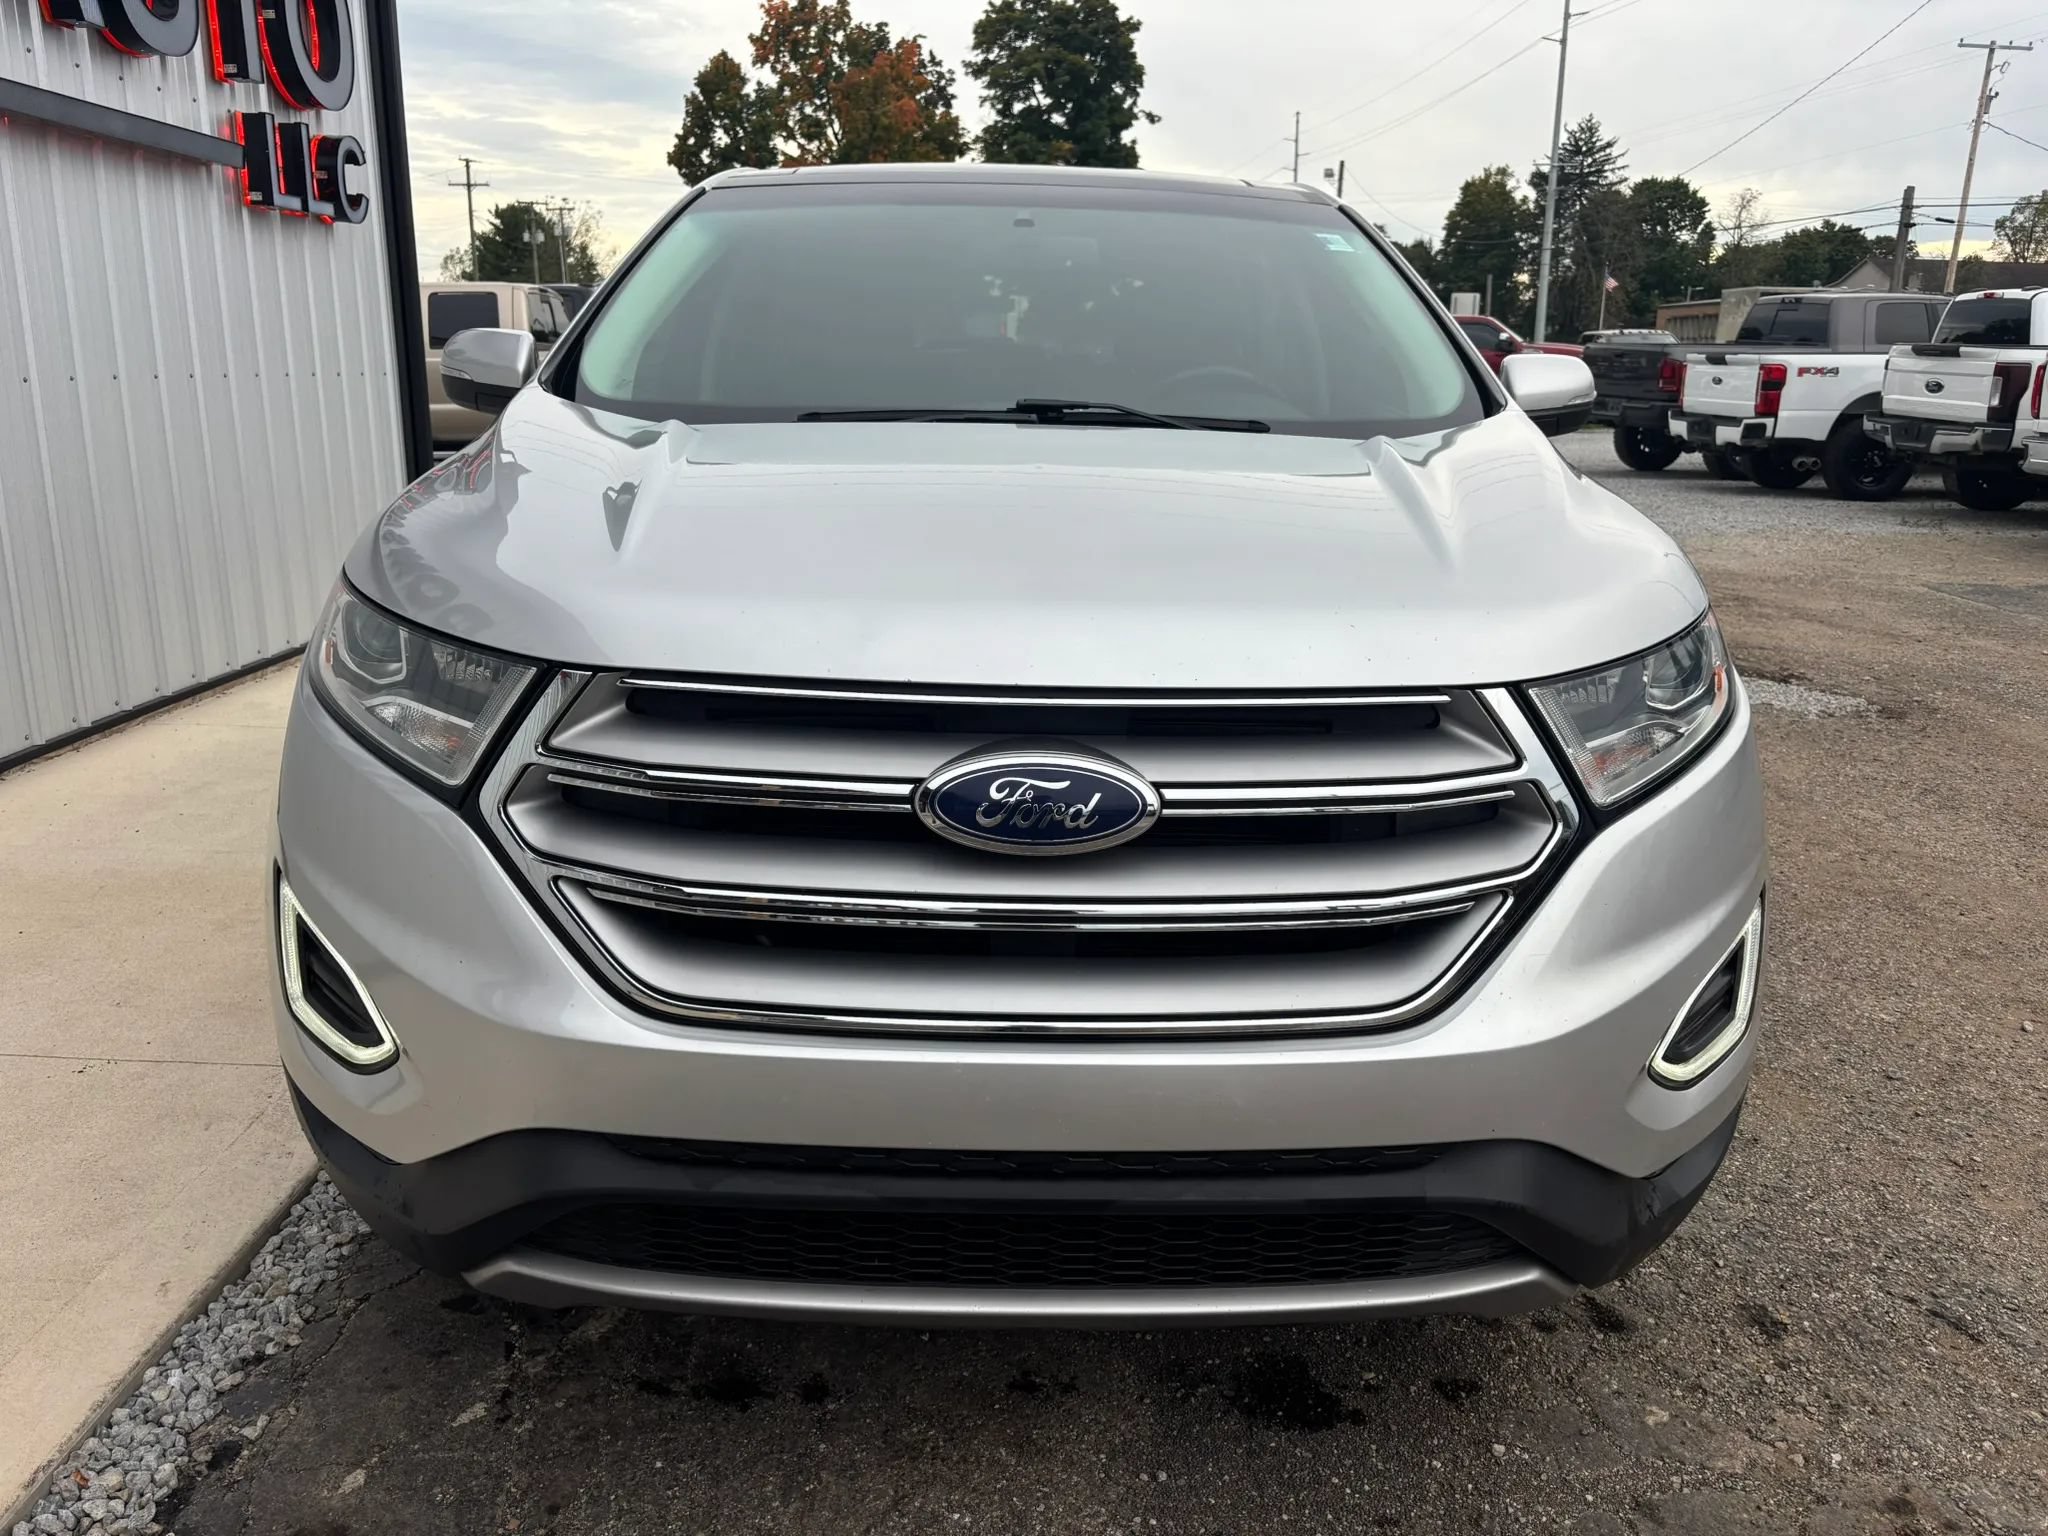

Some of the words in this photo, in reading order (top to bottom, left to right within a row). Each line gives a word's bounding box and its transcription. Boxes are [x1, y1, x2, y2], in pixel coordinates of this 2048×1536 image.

[243, 111, 369, 224] LLC
[1797, 366, 1839, 378] FX4
[975, 776, 1102, 829] Ford
